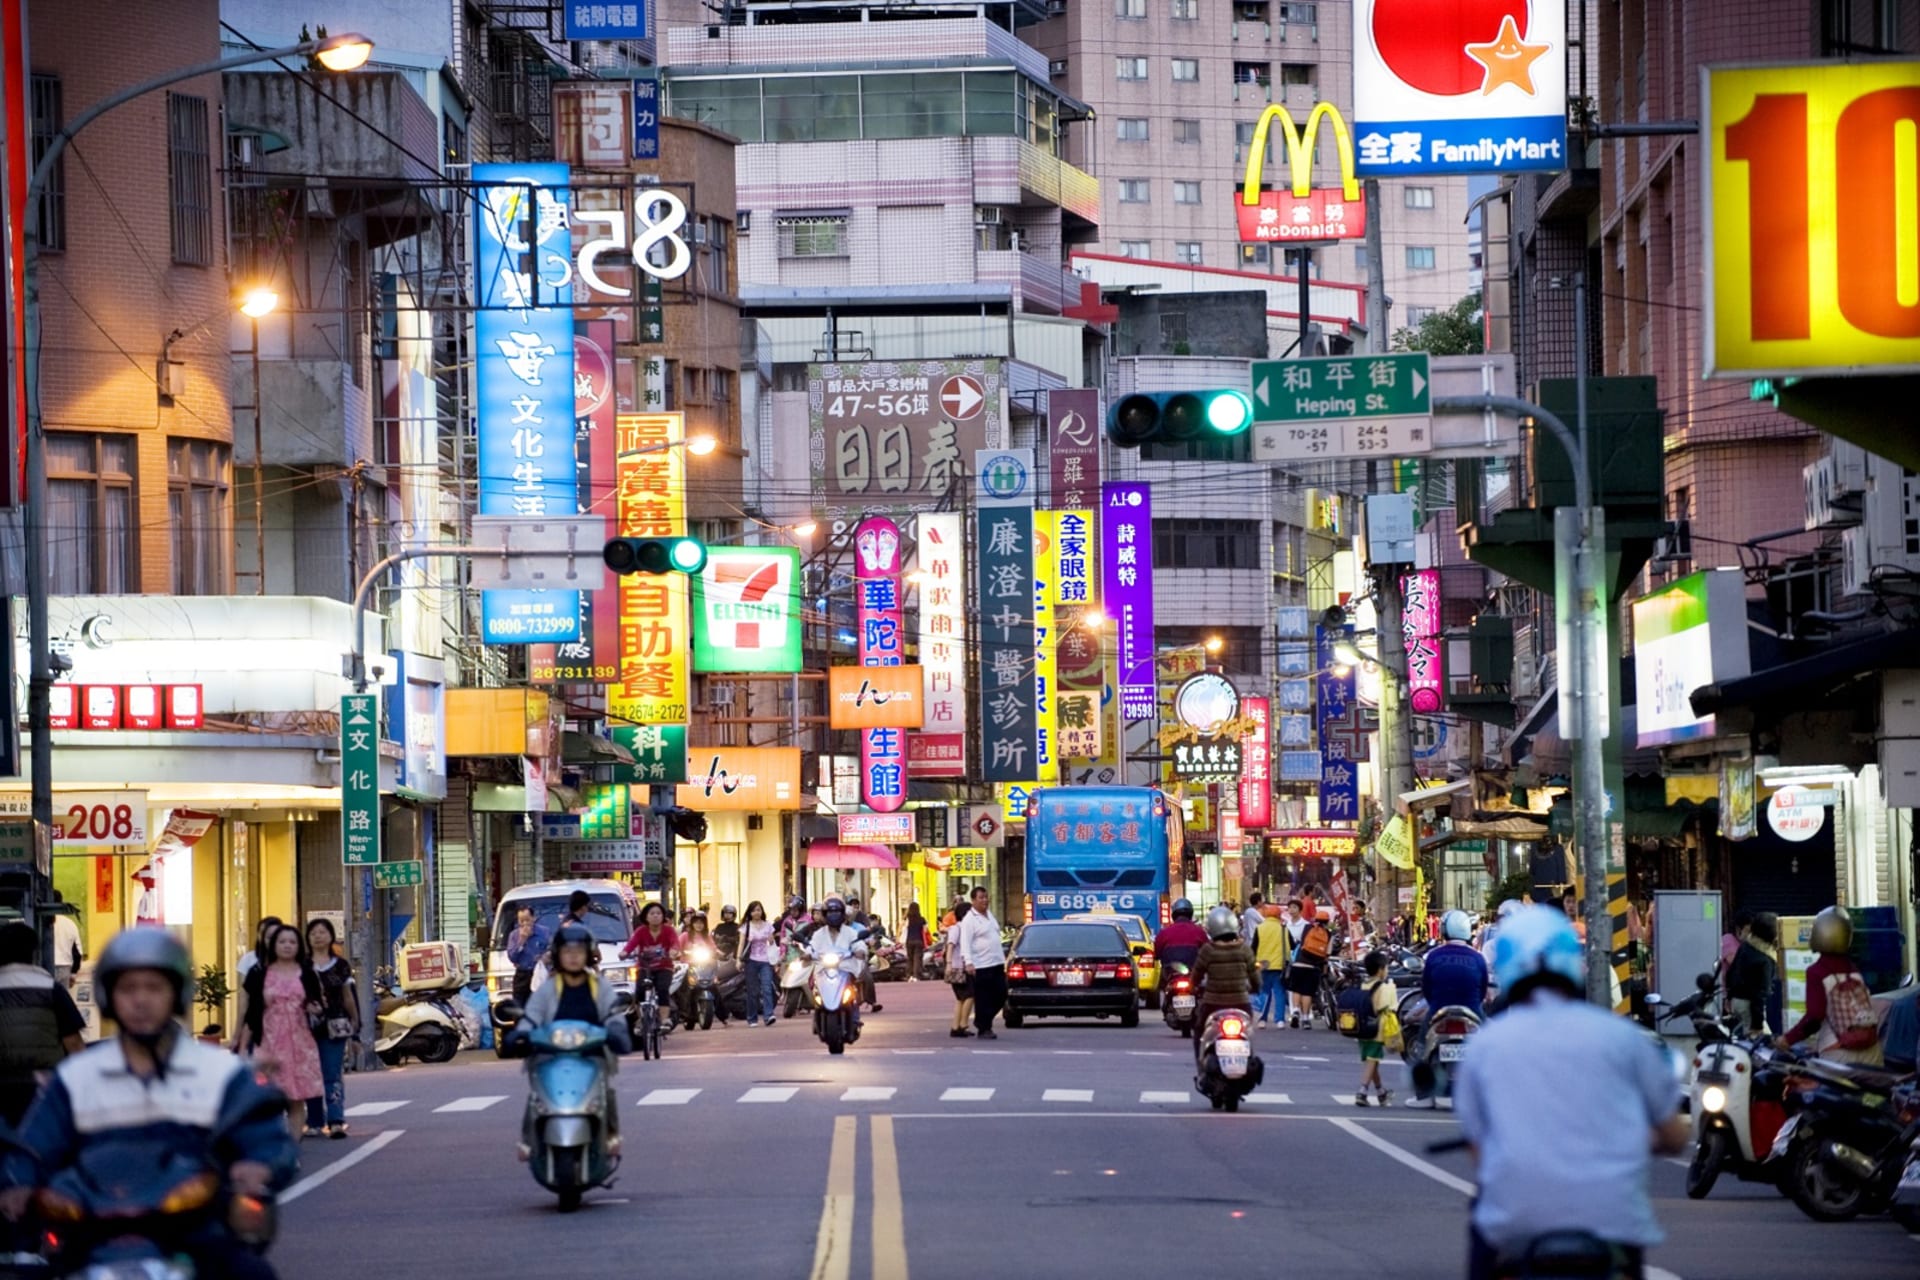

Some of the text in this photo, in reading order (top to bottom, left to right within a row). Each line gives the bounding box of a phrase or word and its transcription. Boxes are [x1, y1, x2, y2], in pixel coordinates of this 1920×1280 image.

[637, 83, 655, 154] 新力牌
[1359, 132, 1422, 165] 全家
[1431, 138, 1560, 166] FamilyMart
[1259, 205, 1345, 224] 麥當勞
[1256, 223, 1347, 238] McDonald's
[1282, 361, 1398, 393] 和平街
[1296, 394, 1389, 415] Heping St.
[1289, 429, 1328, 440] 70-24
[1357, 426, 1388, 438] 24-4
[1410, 428, 1424, 442] 南
[1262, 436, 1275, 449] 北
[1357, 438, 1389, 450] 53-3
[1060, 515, 1087, 601] 全家眼鏡
[489, 617, 575, 634] 0800-732999
[987, 518, 1028, 773] 廉澄中醫診所
[532, 666, 616, 679] 26731139
[349, 698, 369, 713] 東
[628, 704, 685, 722] 2674-2172
[348, 729, 372, 830] 文化路
[1777, 807, 1803, 818] ATM
[67, 804, 132, 840] 208
[132, 827, 143, 840] 元
[349, 835, 373, 843] Wen-
[349, 853, 363, 862] Rd.
[1038, 896, 1055, 904] ETC
